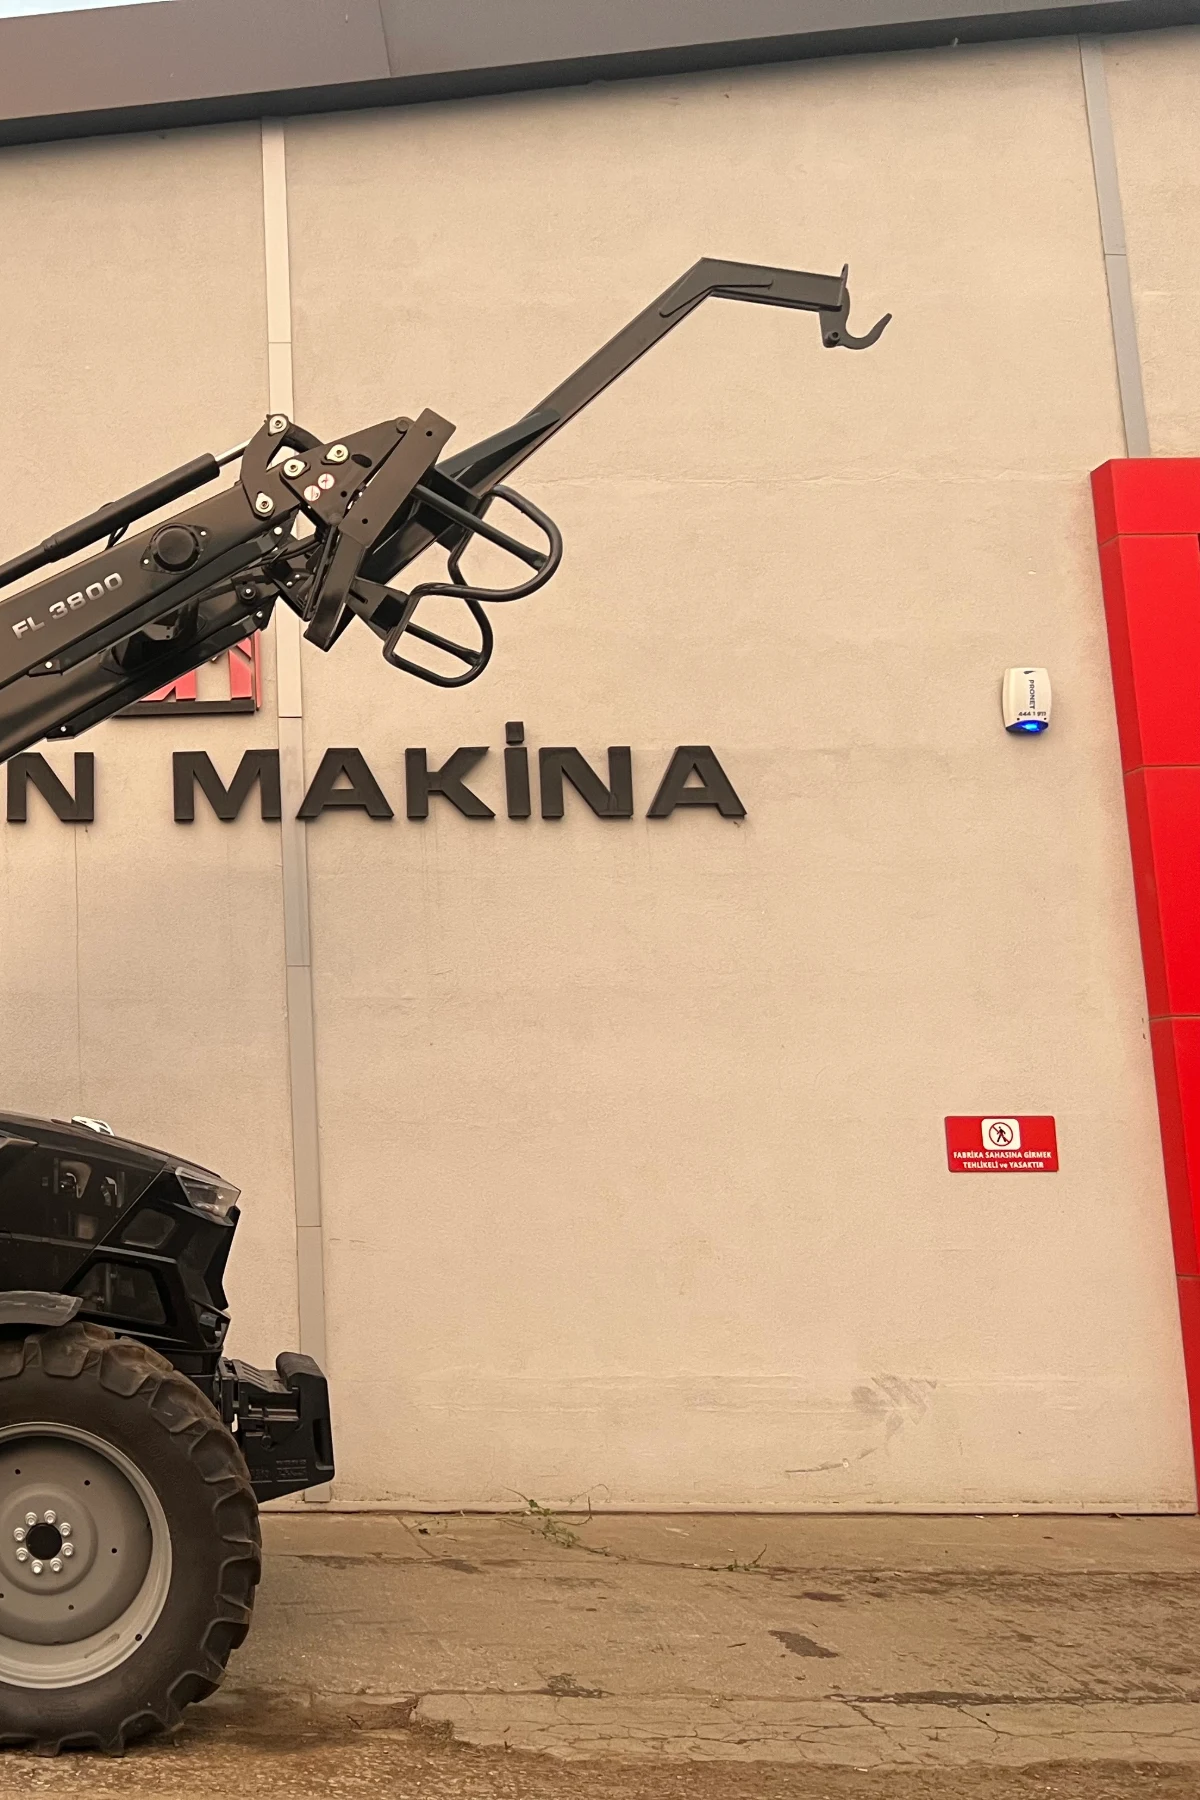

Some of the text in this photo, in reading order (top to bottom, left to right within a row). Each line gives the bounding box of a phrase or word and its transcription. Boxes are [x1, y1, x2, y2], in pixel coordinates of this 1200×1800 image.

[11, 572, 123, 640] FL 3800
[1028, 679, 1036, 709] PRONET
[172, 721, 747, 821] MAKİNA
[953, 1150, 1052, 1159] FABRİKA SAHASINA GİRMEK
[1009, 1161, 1044, 1169] YASAKTIR
